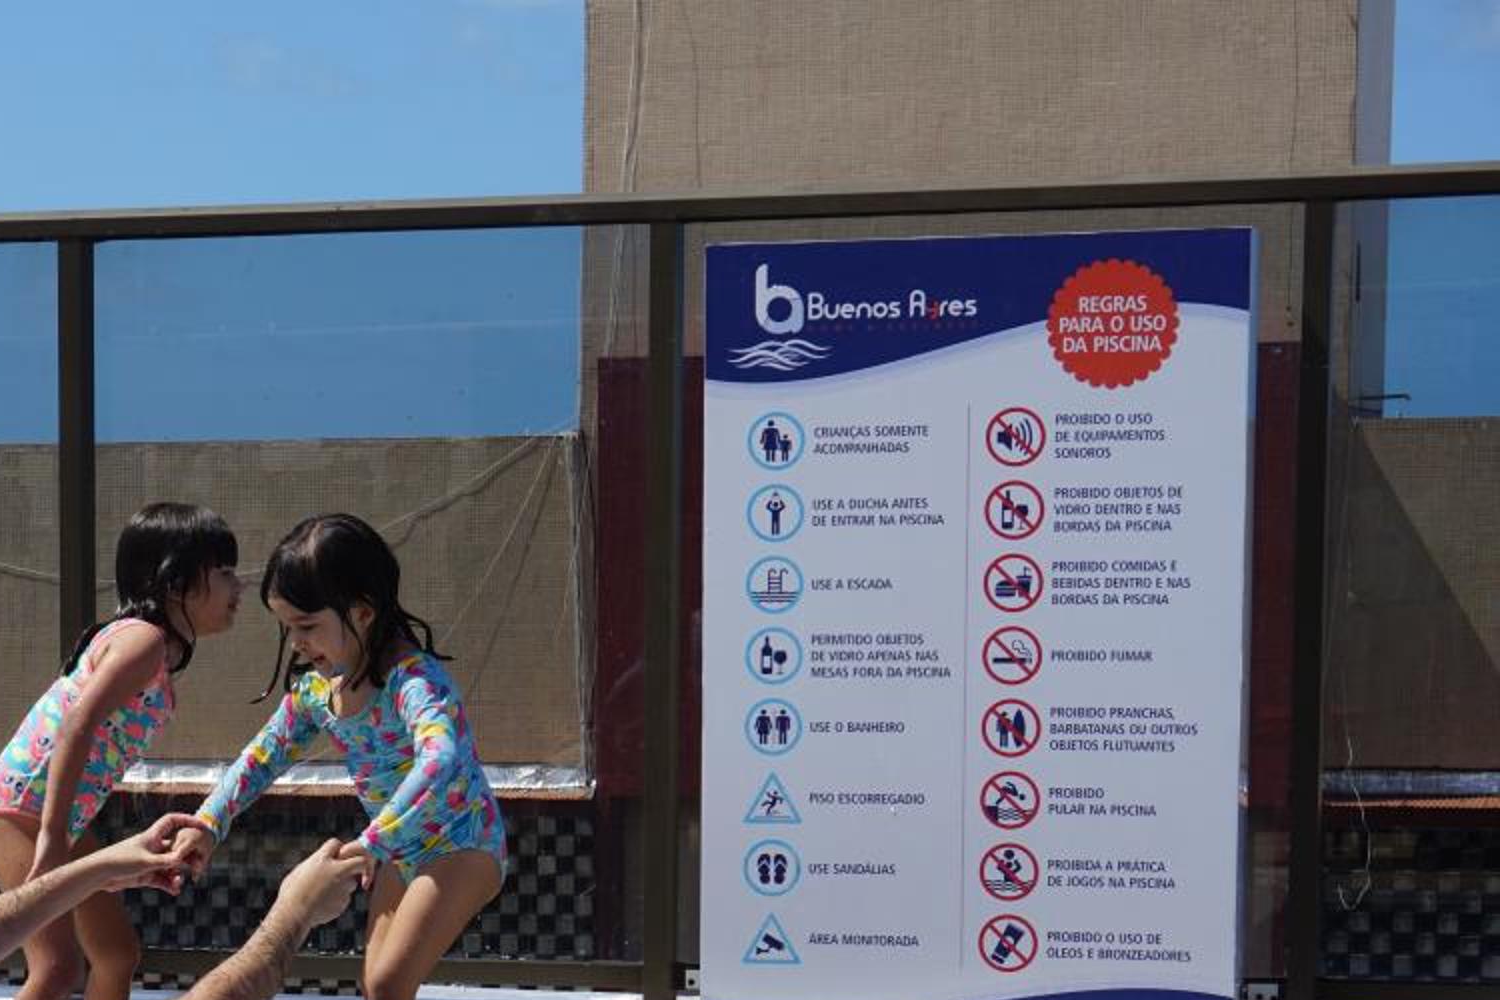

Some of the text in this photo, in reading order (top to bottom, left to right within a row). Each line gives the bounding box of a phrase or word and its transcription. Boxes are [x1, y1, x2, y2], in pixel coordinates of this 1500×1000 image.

[808, 292, 901, 320] Buenos
[1078, 295, 1147, 313] REGRAS
[1060, 315, 1166, 334] PARA O USO
[1062, 334, 1162, 353] DA PISCINA
[1056, 413, 1152, 425] PROIBIDO O USO
[814, 425, 929, 439] CRIANÇAS SOMENTE
[1055, 430, 1164, 442] DE EQUIPAMENTOS
[814, 442, 909, 454] ACOMPANHADAS
[1054, 447, 1111, 459] SONOROS
[1054, 487, 1183, 498] PROIBIDO OBJETOS DE
[813, 498, 928, 510] USE A DUCHA ANTES
[1054, 504, 1181, 515] VIDRO DENTRO E NAS
[812, 514, 944, 527] DE ENTRAR NA PISCINA
[1054, 520, 1172, 532] BORDAS DA PISCINA
[1052, 560, 1177, 572] PROIBIDO COMIDAS E
[811, 579, 892, 590] USE A ESCADA
[1052, 577, 1191, 589] BEBIDAS DENTRO E NAS
[1052, 594, 1169, 605] BORDAS DA PISCINA
[811, 634, 924, 645] PERMITIDO OBJETOS
[811, 650, 939, 661] DE VIDRO APENAS NAS
[1051, 651, 1152, 662] PROIBIDO FUMAR
[811, 667, 951, 678] MESAS FORA DA PISCINA
[1050, 708, 1106, 718] PROIBIDO
[810, 722, 904, 733] USE O BANHEIRO
[1050, 724, 1198, 735] BARBATANAS OU OUTROS
[1049, 740, 1175, 752] OBJETOS FLUTUANTES
[1048, 787, 1105, 799] PROIBIDO
[810, 794, 925, 805] PISO ESCORREGADIO
[1048, 804, 1156, 816] PULAR NA PISCINA
[809, 861, 896, 875] USE SANDÁLIAS
[1048, 858, 1165, 872] PROIBIDA A PRÁTICA
[1048, 876, 1175, 889] DE JOGOS NA PISCINA
[842, 936, 919, 947] MONITORADA
[1048, 932, 1162, 944] PROIBIDO O USO DE
[1087, 949, 1093, 960] E
[1098, 949, 1191, 962] BRONZEADORES
